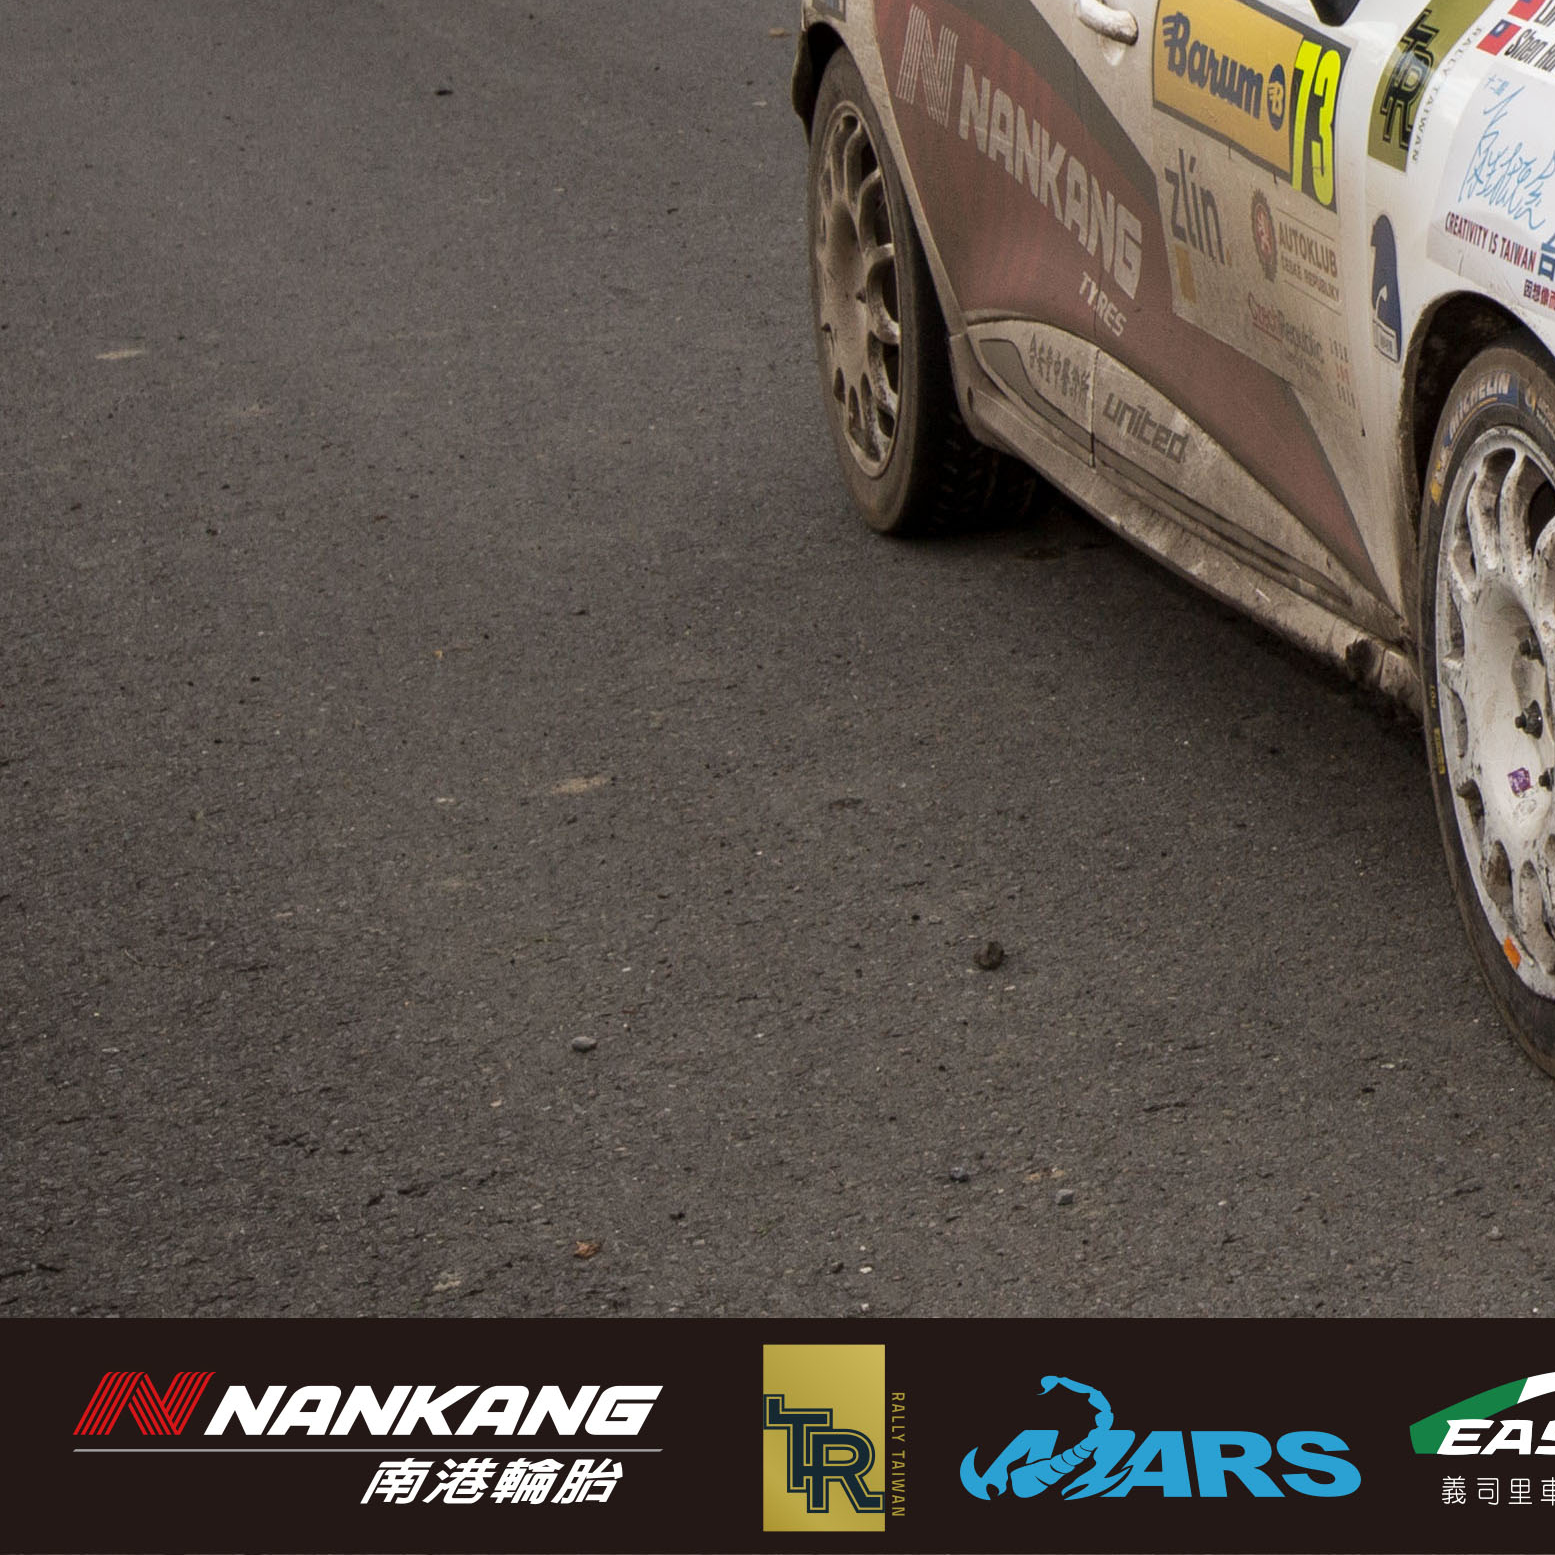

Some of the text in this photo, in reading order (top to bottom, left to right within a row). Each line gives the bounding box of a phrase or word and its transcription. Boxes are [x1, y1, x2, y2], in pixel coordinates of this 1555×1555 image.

[1162, 10, 1264, 120] Barum
[1504, 28, 1548, 65] Shen
[1292, 39, 1342, 206] 73
[1412, 27, 1483, 162] RALLY TAIWAN
[959, 64, 1142, 300] NANKANG
[1278, 221, 1339, 279] AUTOKLUB
[1444, 211, 1538, 273] CREATIVITY IS TAIWAN
[1079, 271, 1128, 337] TYRES
